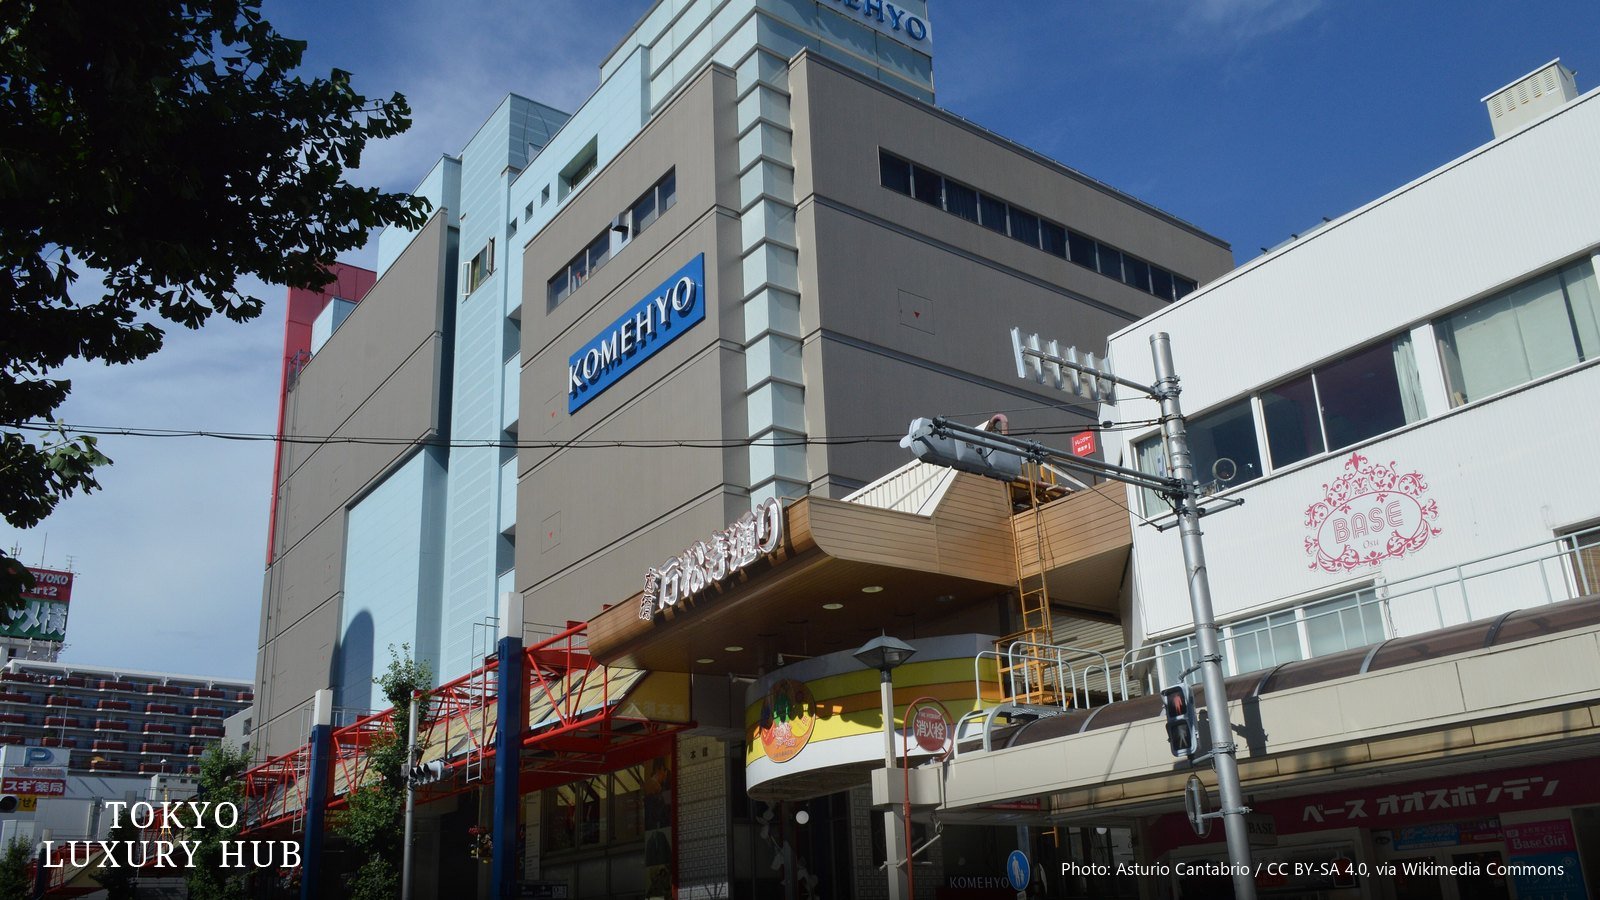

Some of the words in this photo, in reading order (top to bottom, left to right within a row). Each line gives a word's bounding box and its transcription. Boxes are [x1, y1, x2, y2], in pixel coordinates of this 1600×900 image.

[568, 276, 695, 396] KOMEHYO
[1333, 500, 1404, 544] BASE
[659, 496, 781, 609] 万松寺通り
[916, 719, 945, 740] 消火栓
[3, 780, 64, 793] スギ薬局
[1303, 799, 1368, 823] ベース
[1376, 776, 1560, 816] オオスホンテン
[1247, 822, 1274, 834] BASE
[949, 876, 1010, 889] KOMEHYO
